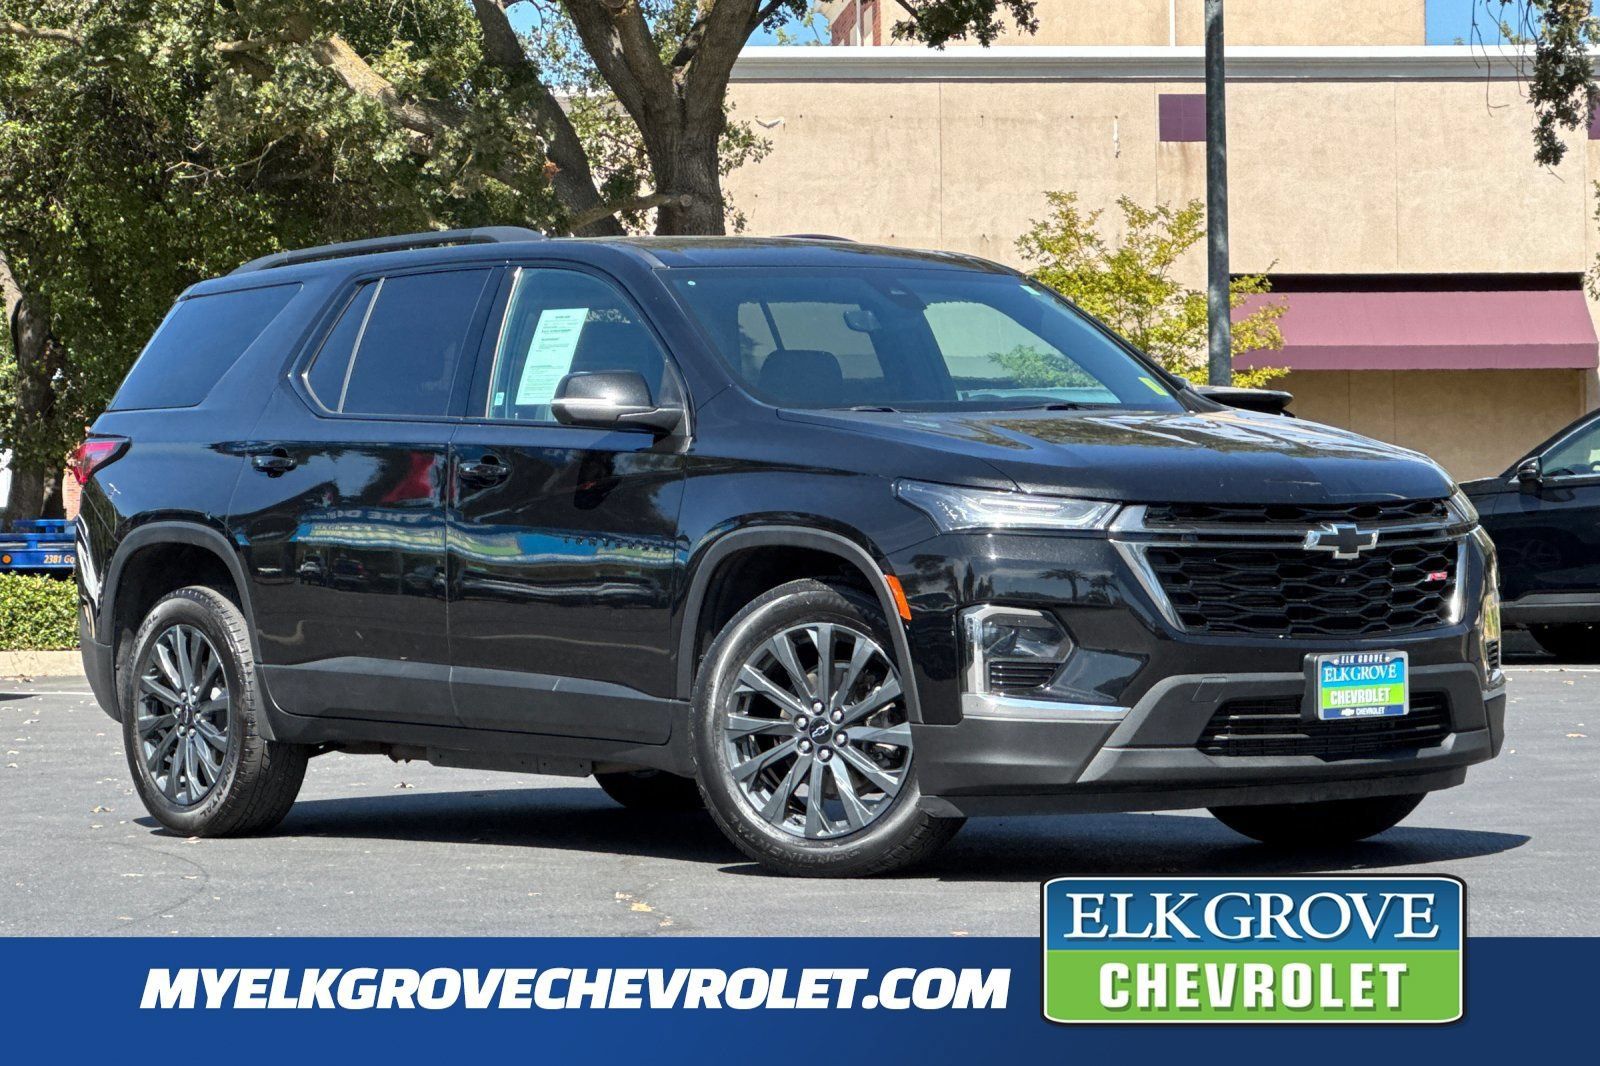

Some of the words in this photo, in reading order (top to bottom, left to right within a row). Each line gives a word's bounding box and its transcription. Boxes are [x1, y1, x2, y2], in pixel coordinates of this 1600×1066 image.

[1324, 667, 1349, 683] ELK
[1350, 664, 1397, 681] GROVE
[1331, 688, 1391, 705] CHEVROLET
[1356, 707, 1385, 715] CHEVROLET
